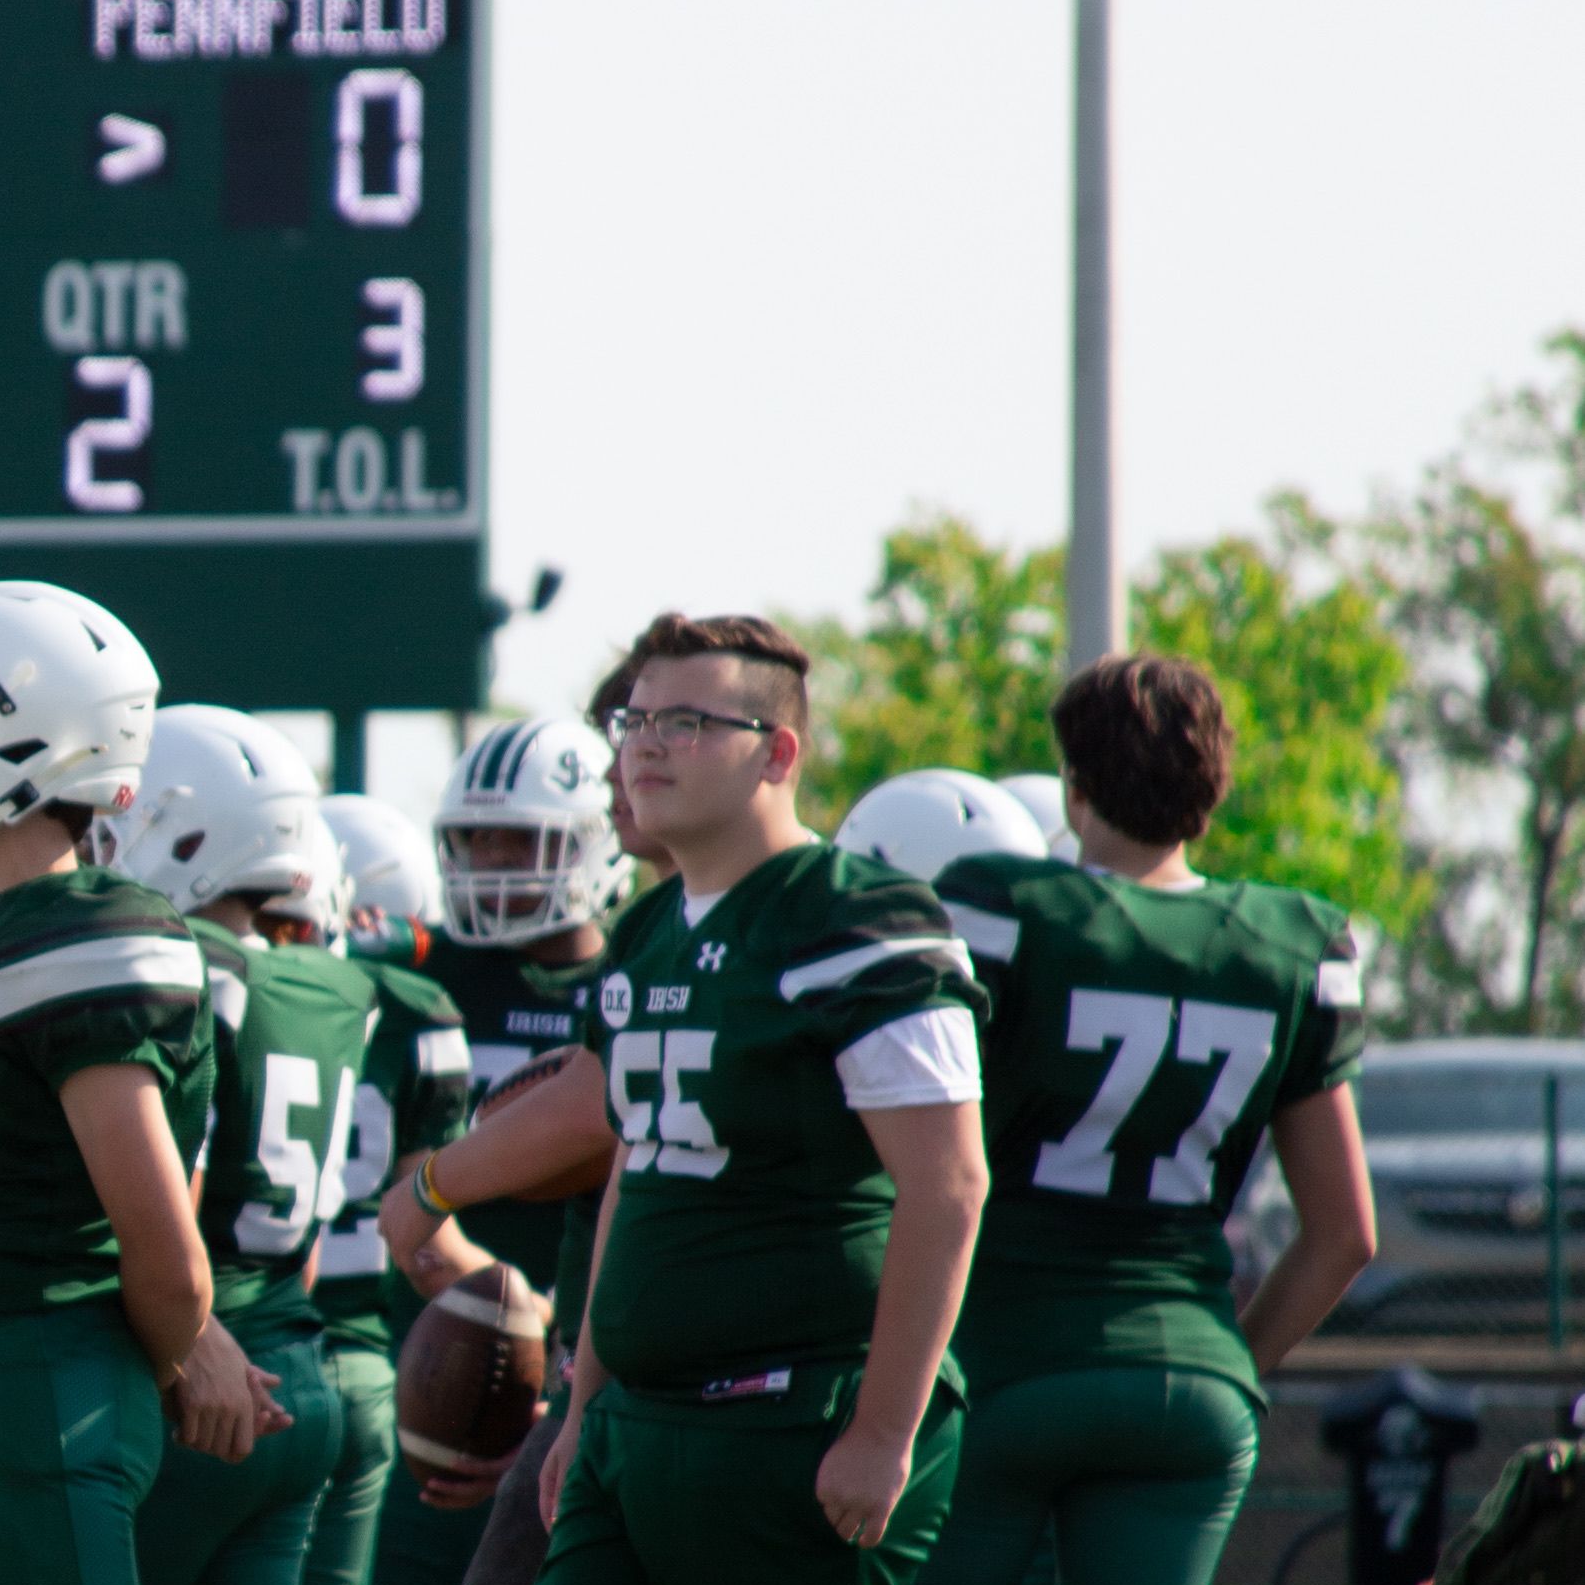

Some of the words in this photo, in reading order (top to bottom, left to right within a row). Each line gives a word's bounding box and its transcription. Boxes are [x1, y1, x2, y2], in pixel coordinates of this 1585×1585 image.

[335, 67, 424, 226] 0
[41, 259, 189, 351] QTR
[362, 276, 426, 401] 3
[65, 354, 153, 513] 2
[281, 427, 459, 515] T.O.L.
[505, 1010, 572, 1038] IRISH
[608, 1028, 731, 1180] 55
[1031, 987, 1277, 1206] 77
